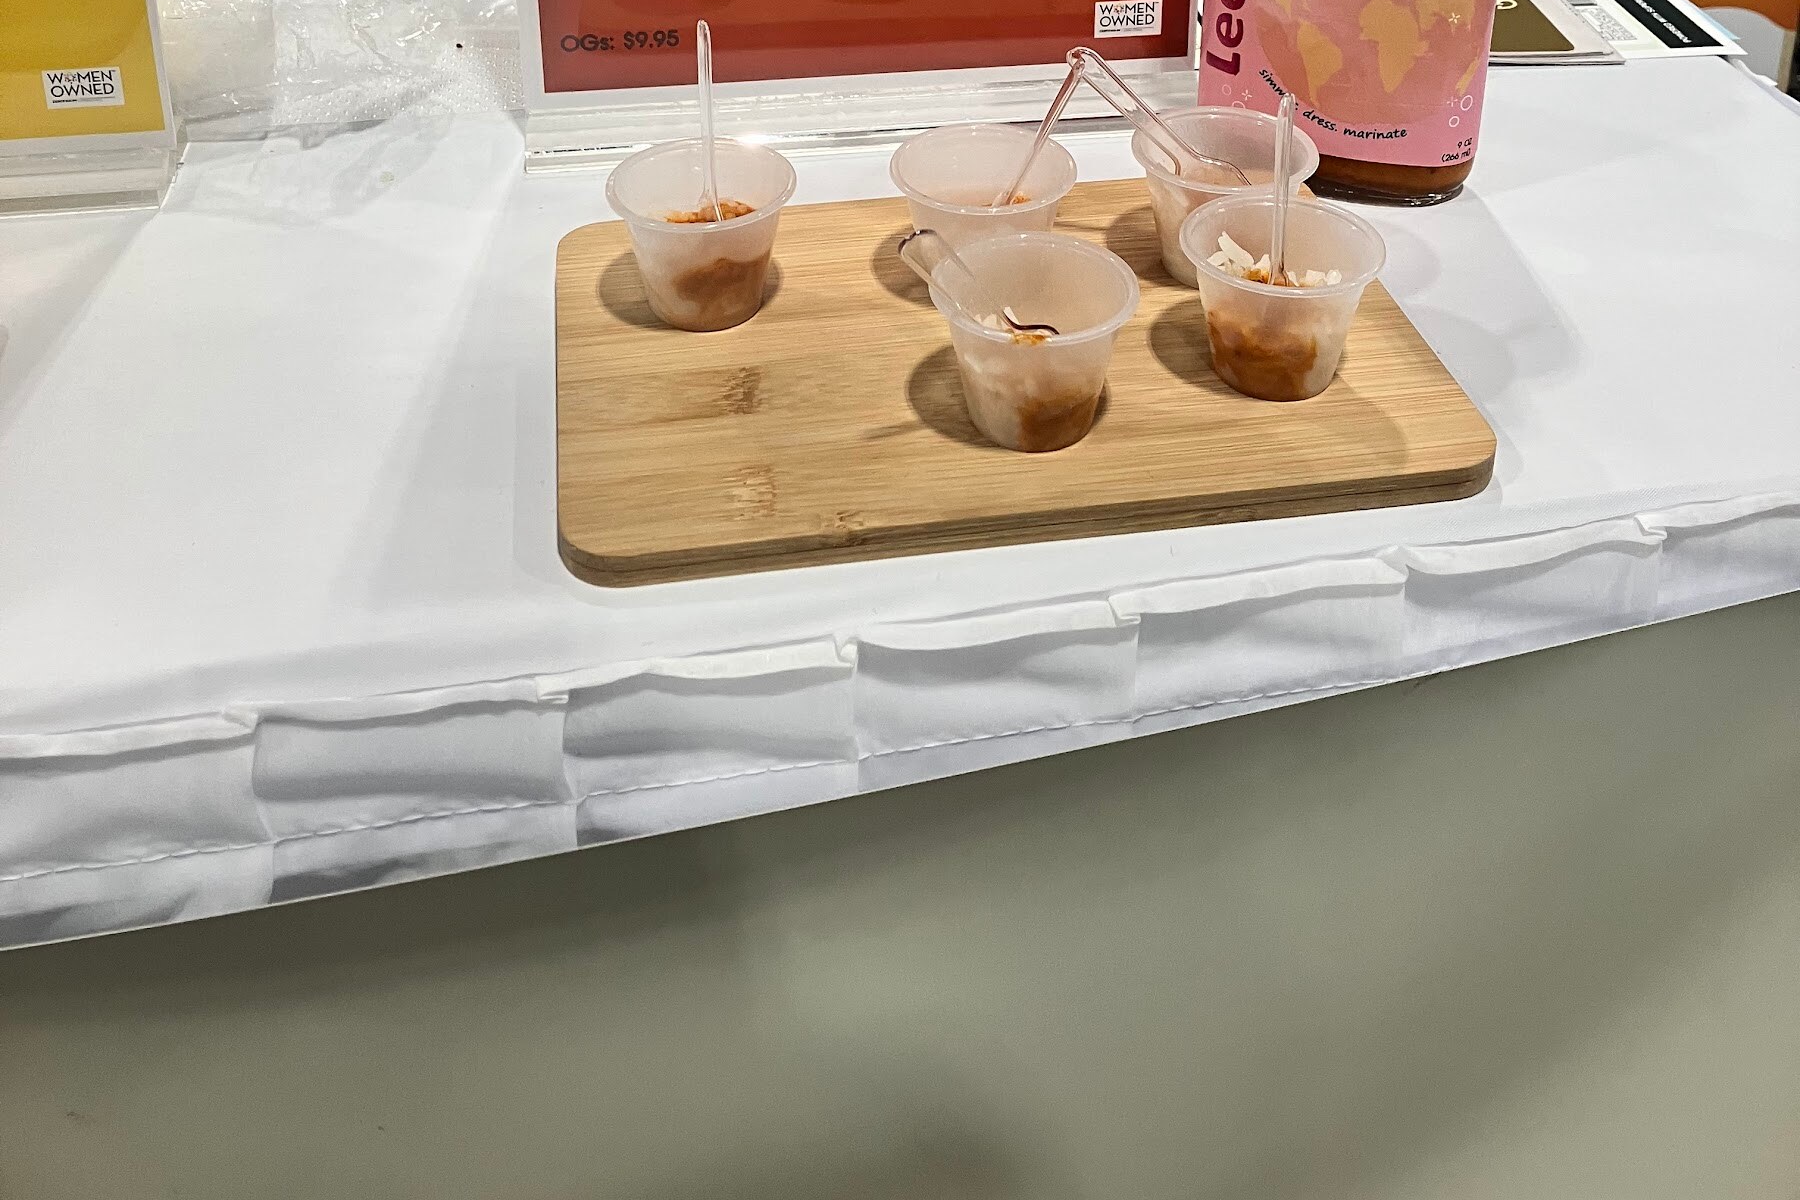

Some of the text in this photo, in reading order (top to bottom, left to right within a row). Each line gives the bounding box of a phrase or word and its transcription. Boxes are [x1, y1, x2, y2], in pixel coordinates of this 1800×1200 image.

[1099, 13, 1155, 28] OWNED
[560, 28, 681, 53] OGs: $9.95
[50, 82, 115, 98] OWNED
[1302, 109, 1339, 133] dress.
[1343, 127, 1408, 140] marinate
